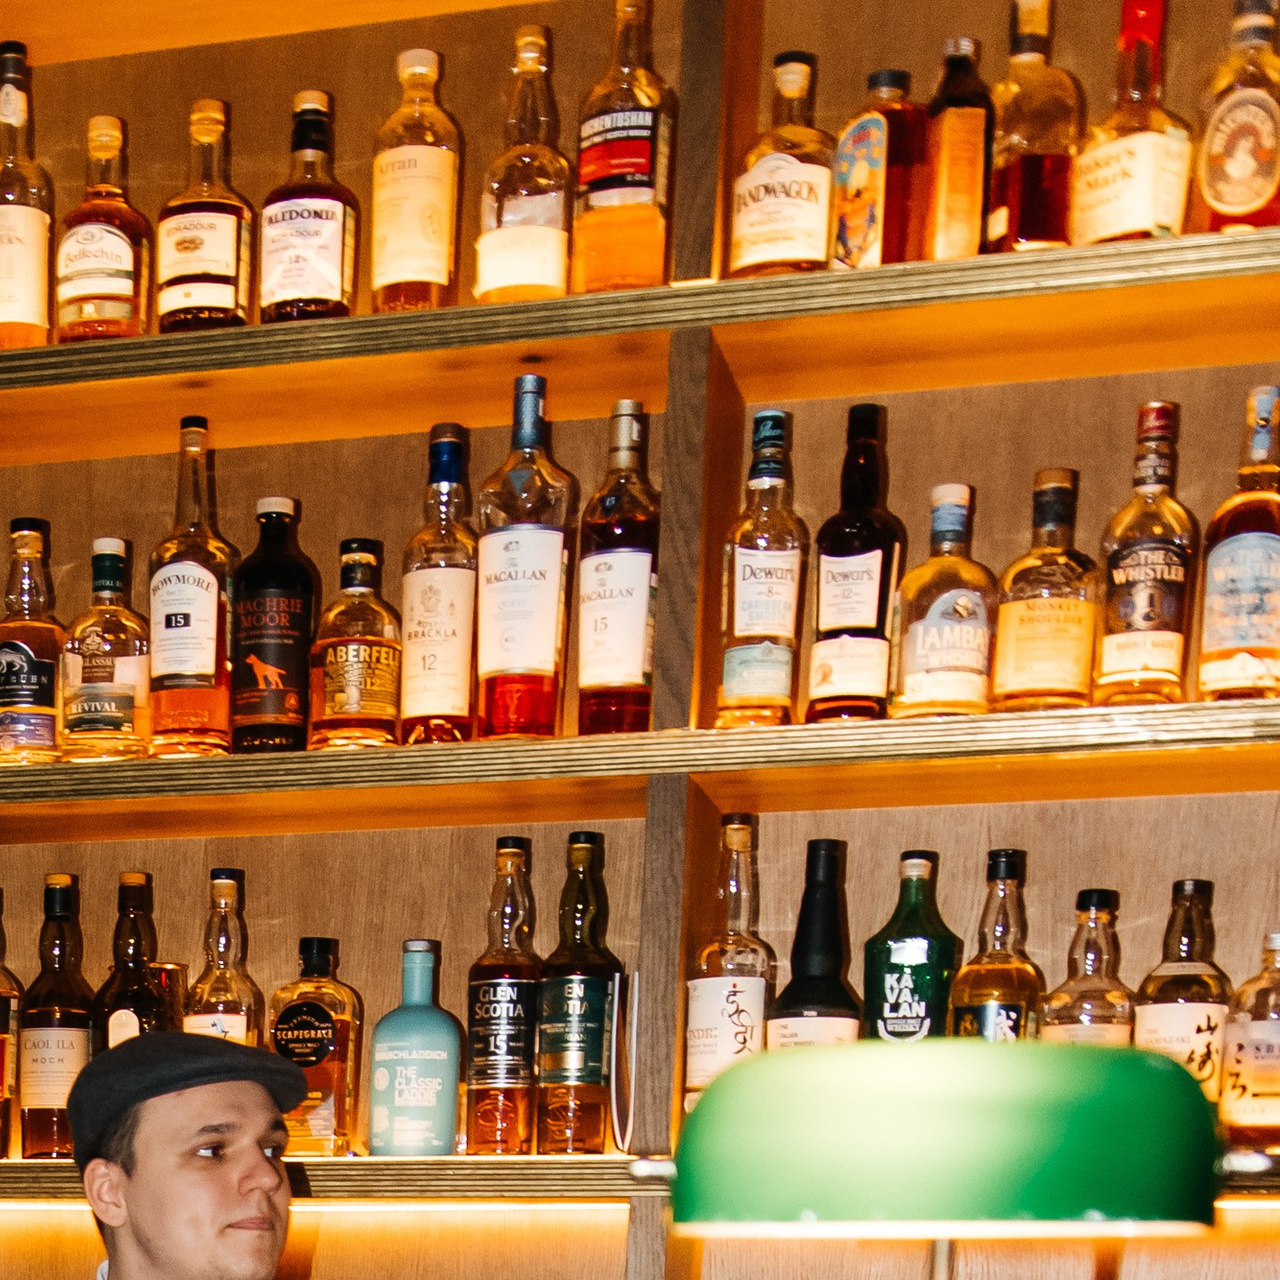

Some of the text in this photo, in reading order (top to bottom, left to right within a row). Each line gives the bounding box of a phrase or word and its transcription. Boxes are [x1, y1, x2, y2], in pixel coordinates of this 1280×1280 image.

[485, 569, 548, 585] MACALLAN
[151, 574, 213, 597] BOWMORE
[171, 615, 185, 628] 15
[240, 612, 290, 628] MOOR
[593, 616, 608, 632] 15
[407, 628, 458, 642] BRACKLA
[422, 653, 438, 671] 12
[479, 985, 518, 1002] GLEN
[474, 1002, 525, 1019] SCOTIA
[276, 1028, 334, 1041] SCAPEGRACE
[24, 1038, 76, 1052] CAOL ILA
[488, 1034, 508, 1054] 15
[31, 1057, 65, 1065] MOCH
[394, 1066, 418, 1079] THE
[394, 1078, 443, 1092] CLASSIC
